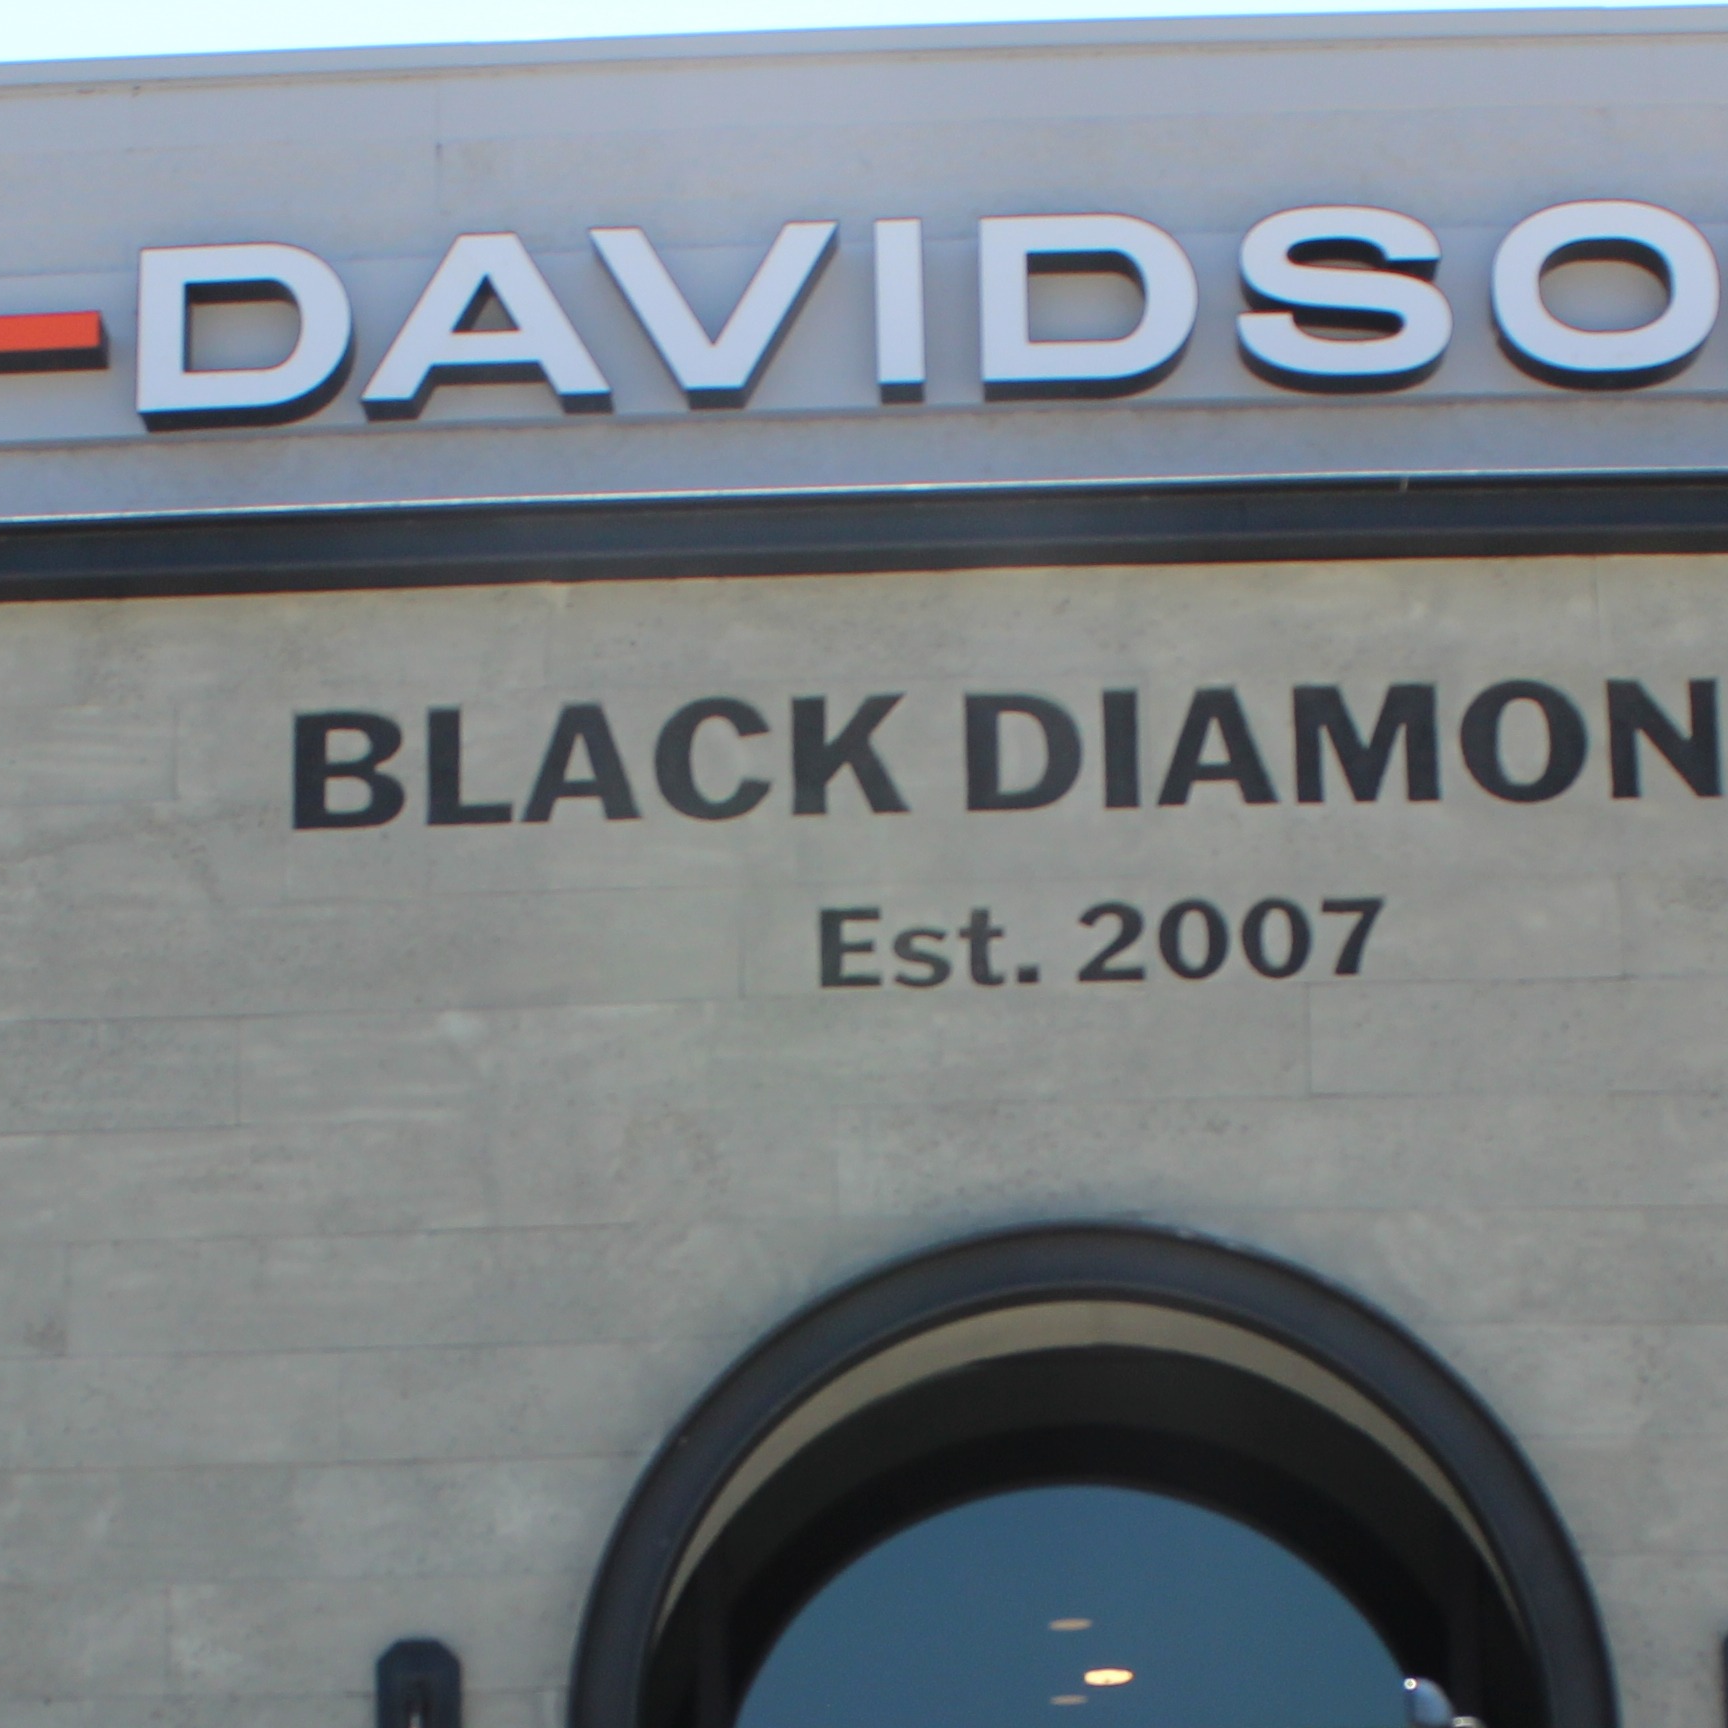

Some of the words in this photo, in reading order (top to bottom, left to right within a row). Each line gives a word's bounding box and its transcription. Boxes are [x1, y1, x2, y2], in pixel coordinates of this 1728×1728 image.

[291, 691, 912, 831] BLACK
[818, 905, 1041, 989] Est.
[1076, 895, 1387, 984] 2007
